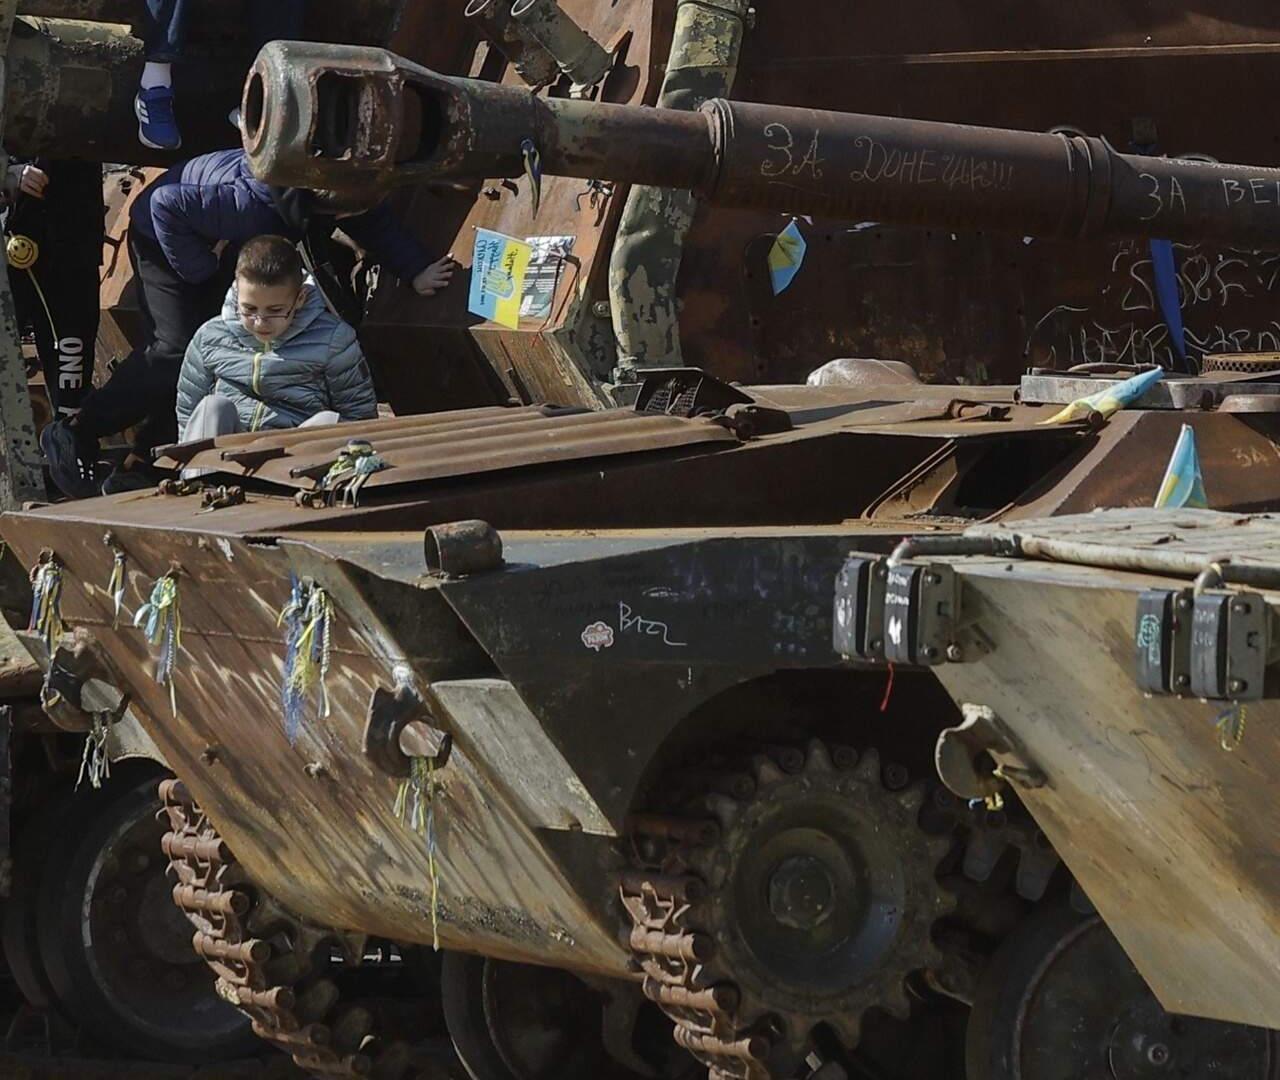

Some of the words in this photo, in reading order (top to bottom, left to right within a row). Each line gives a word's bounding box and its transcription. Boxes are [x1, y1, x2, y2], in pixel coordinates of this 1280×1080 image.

[760, 122, 825, 181] ЗА
[1138, 173, 1187, 221] ЗА
[58, 337, 84, 390] ONE
